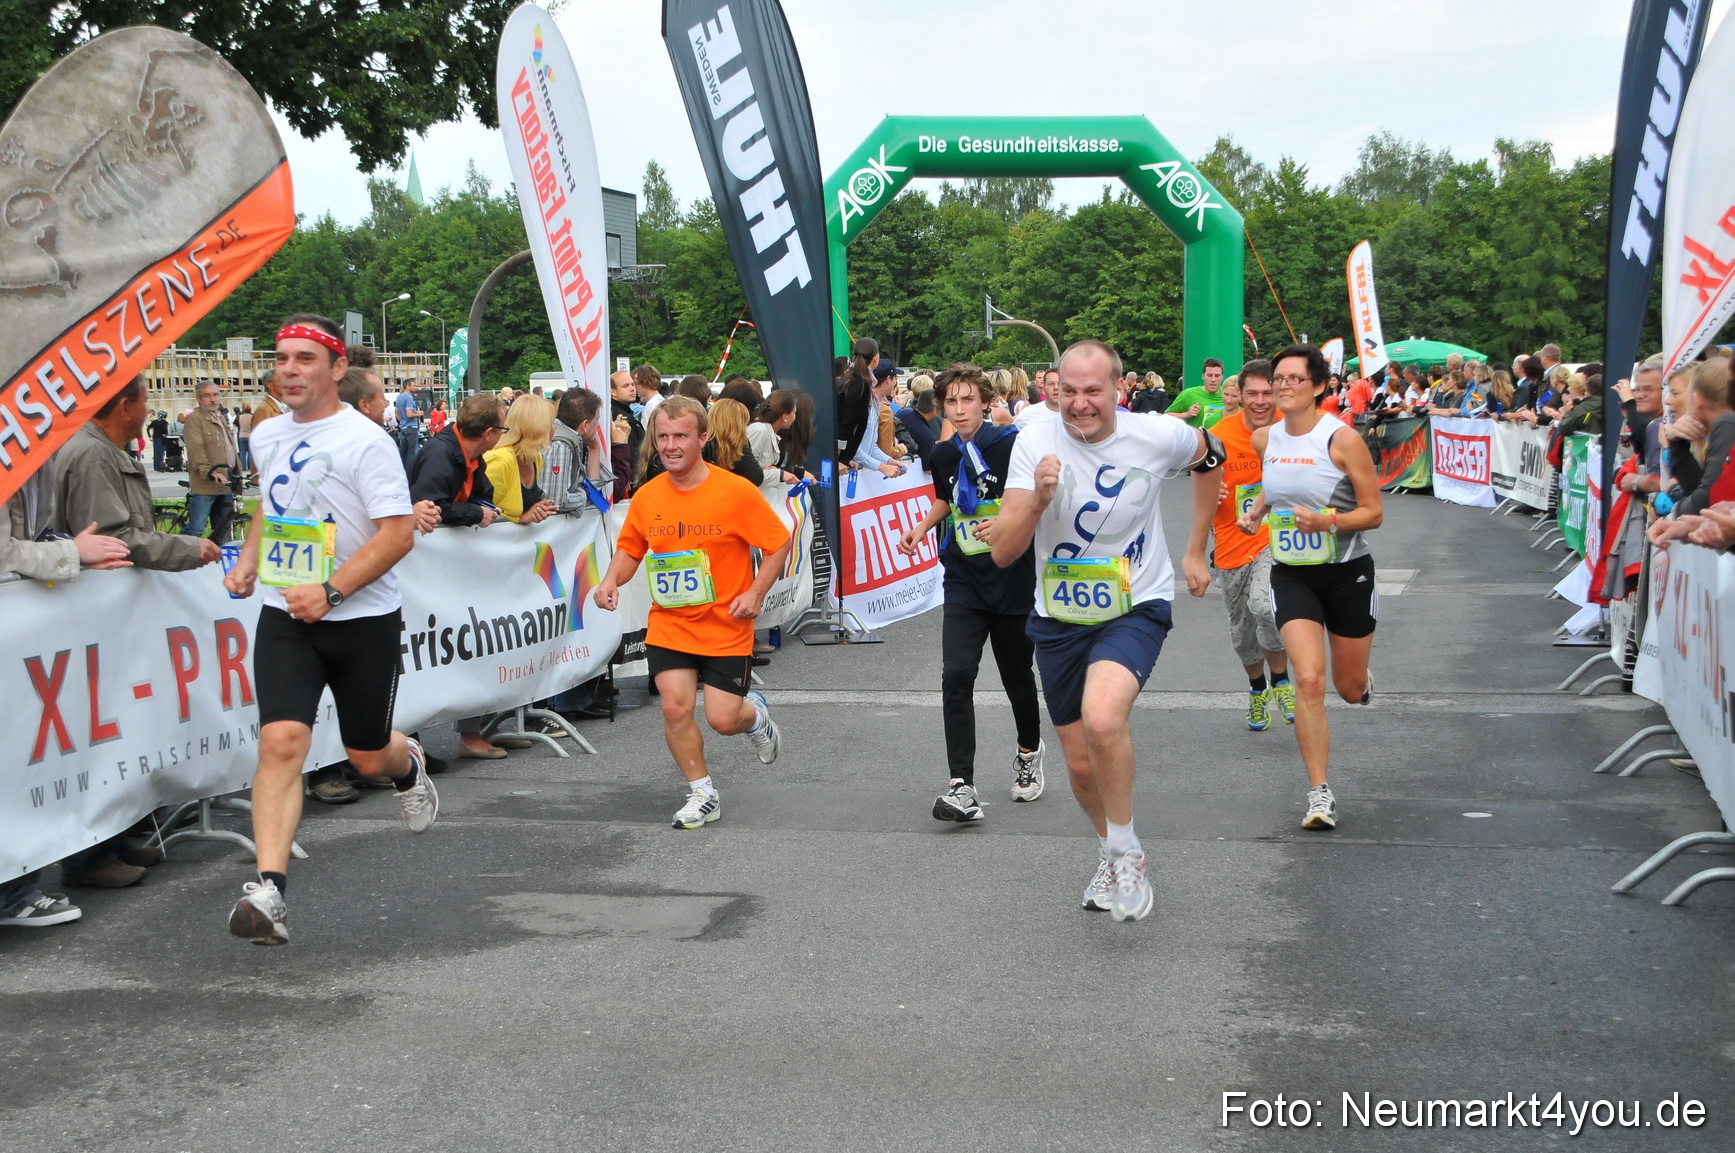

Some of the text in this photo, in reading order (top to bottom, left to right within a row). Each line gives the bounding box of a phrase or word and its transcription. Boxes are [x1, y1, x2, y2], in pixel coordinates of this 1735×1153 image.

[918, 134, 1124, 155] Die Gesundheitskasse.
[836, 143, 908, 236] AOK
[1139, 160, 1223, 232] AOK
[1355, 257, 1373, 333] KLEBL
[1229, 461, 1258, 471] EURO
[1280, 457, 1318, 466] KLEBL
[1436, 434, 1487, 482] MEIER
[648, 524, 722, 537] EURO POLES
[851, 494, 938, 586] MEIER
[1278, 529, 1322, 552] 500
[267, 541, 313, 572] 471
[656, 569, 699, 594] 575
[1052, 581, 1112, 609] 466
[498, 658, 535, 685] Druck
